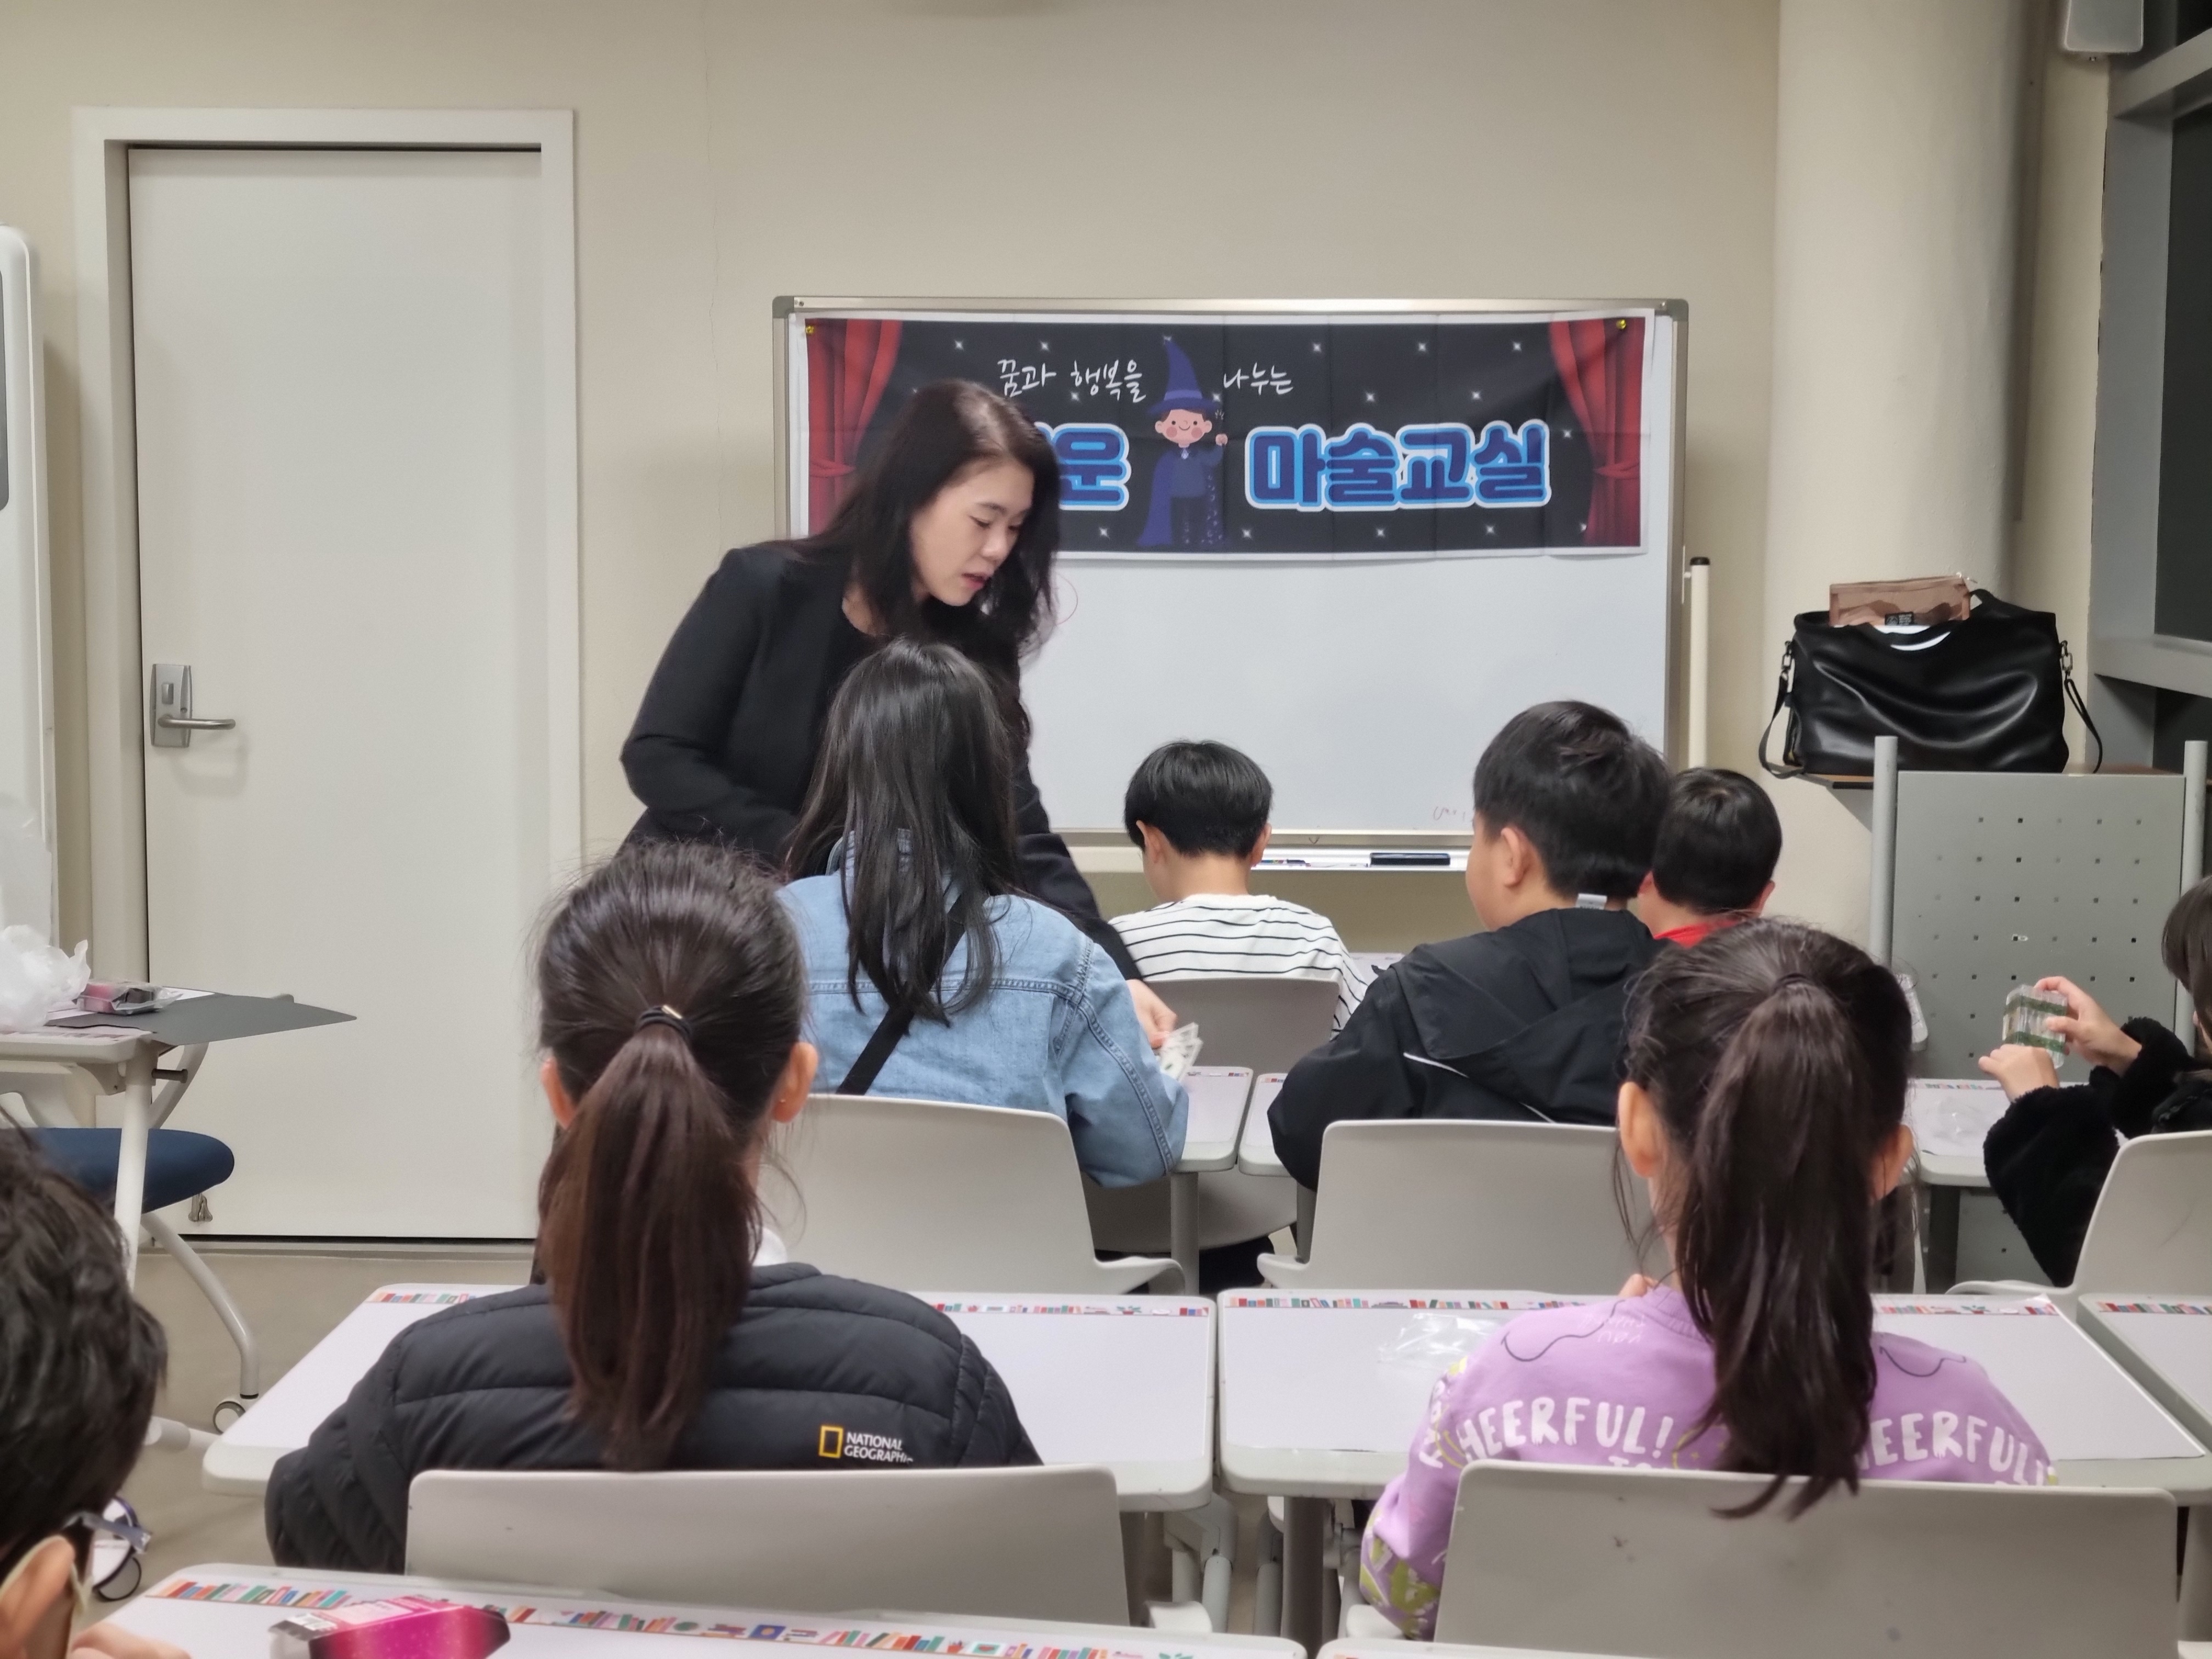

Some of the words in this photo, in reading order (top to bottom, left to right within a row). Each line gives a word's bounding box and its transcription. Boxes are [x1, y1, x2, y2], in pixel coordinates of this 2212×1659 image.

[997, 359, 1057, 398] 꿈과
[1070, 359, 1146, 403] 행복을
[1223, 362, 1294, 395] 나누는
[1245, 419, 1551, 511] 마술교실
[847, 1431, 902, 1451] NATIONAL
[1455, 1396, 1673, 1462] HEERFUL!
[1855, 1410, 2047, 1486] EERFUL!
